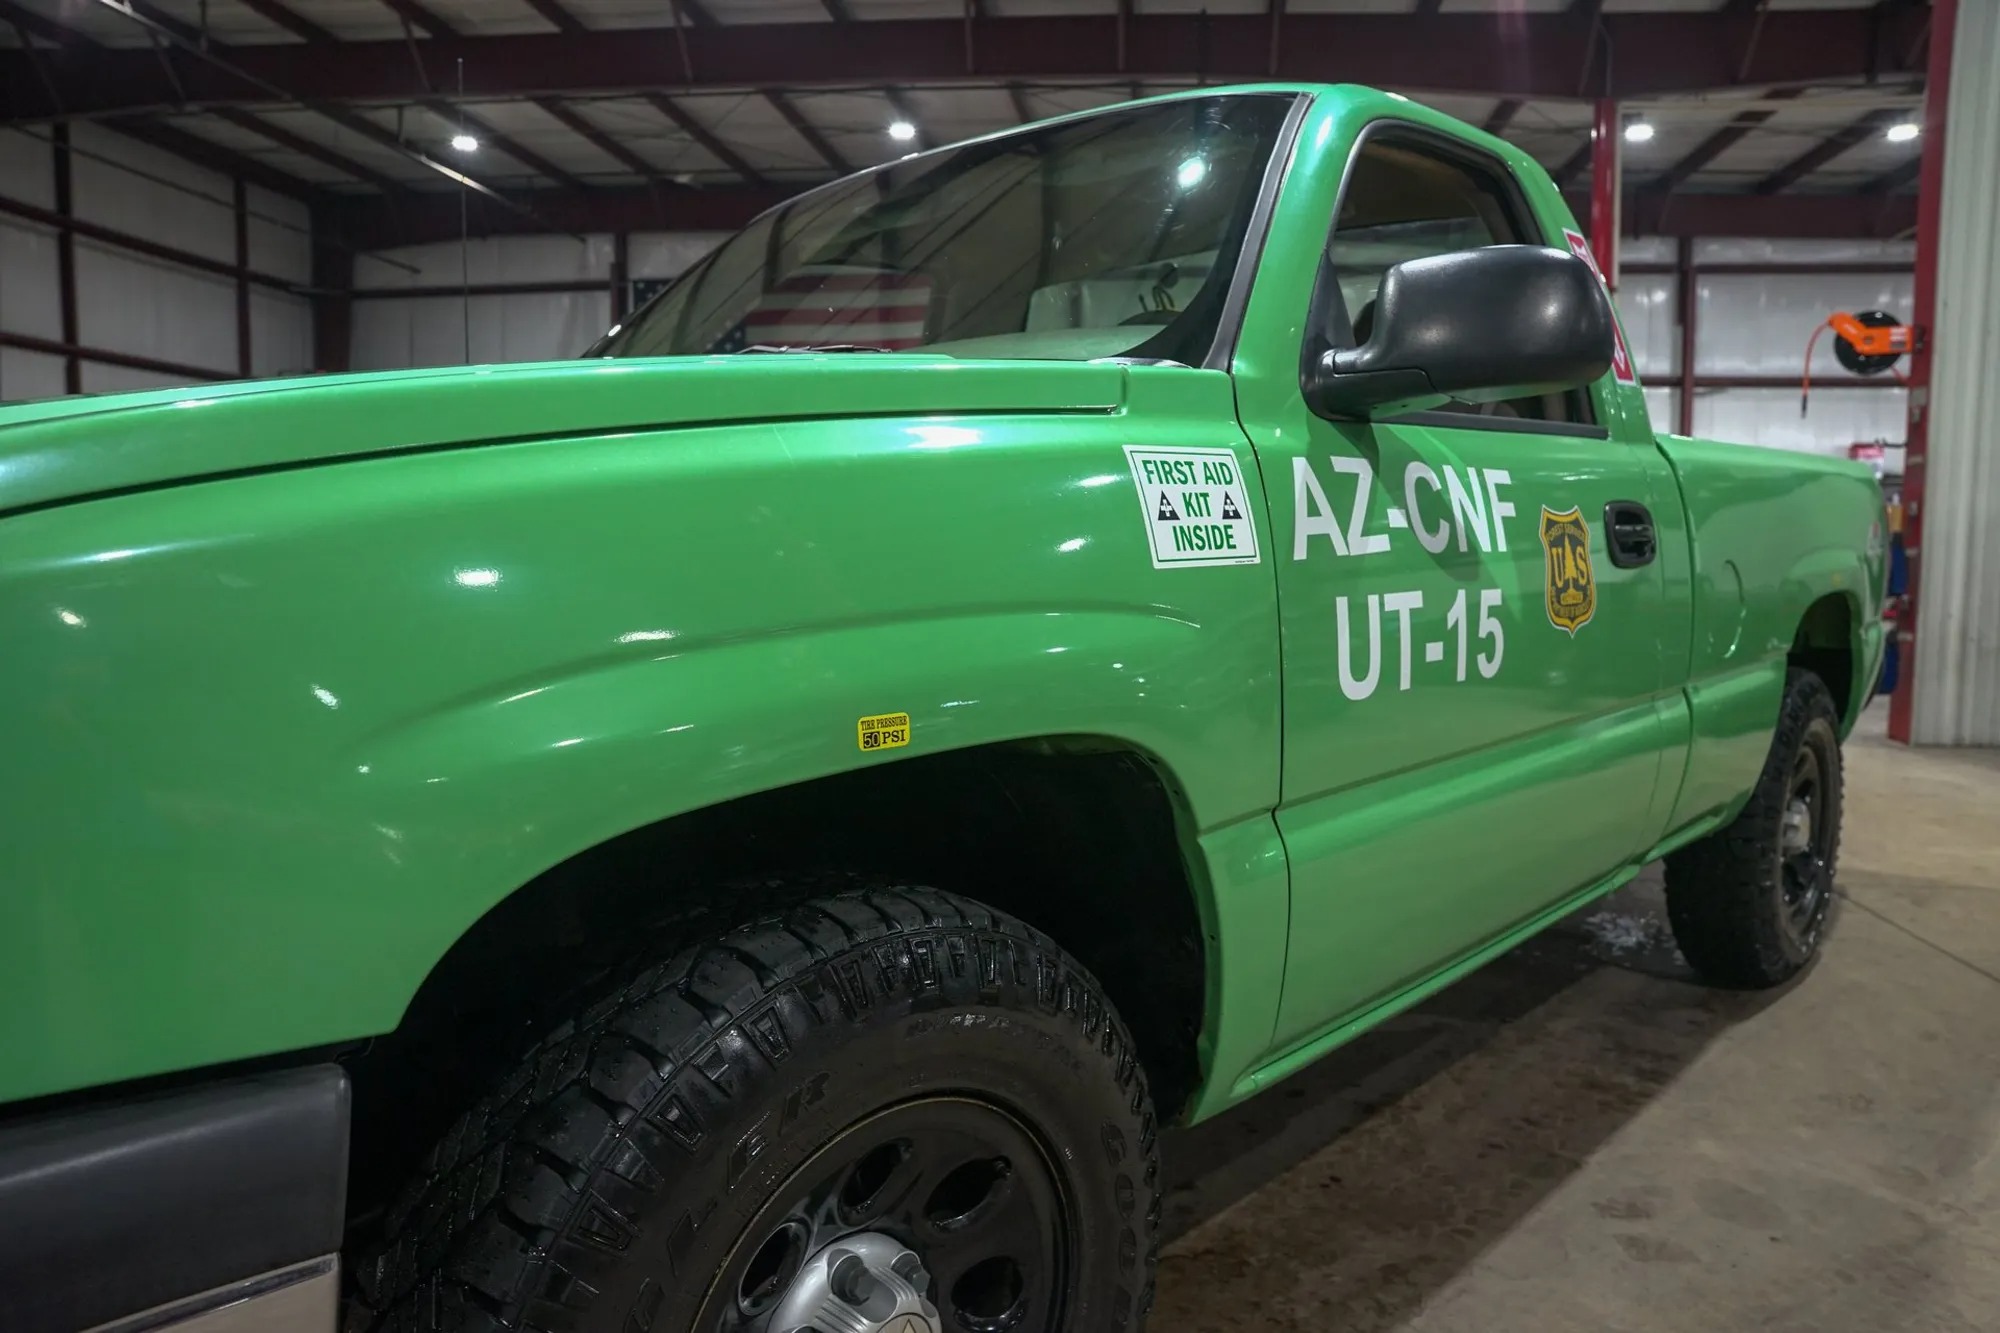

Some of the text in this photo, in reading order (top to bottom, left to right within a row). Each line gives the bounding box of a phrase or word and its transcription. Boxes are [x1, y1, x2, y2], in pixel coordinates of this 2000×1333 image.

[1141, 460, 1234, 486] FIRST AID
[1182, 492, 1211, 517] KIT
[1292, 455, 1516, 560] AZ-CNF
[1173, 524, 1237, 551] INSIDE
[1336, 588, 1505, 701] UT-15
[864, 730, 906, 748] 50 PSI
